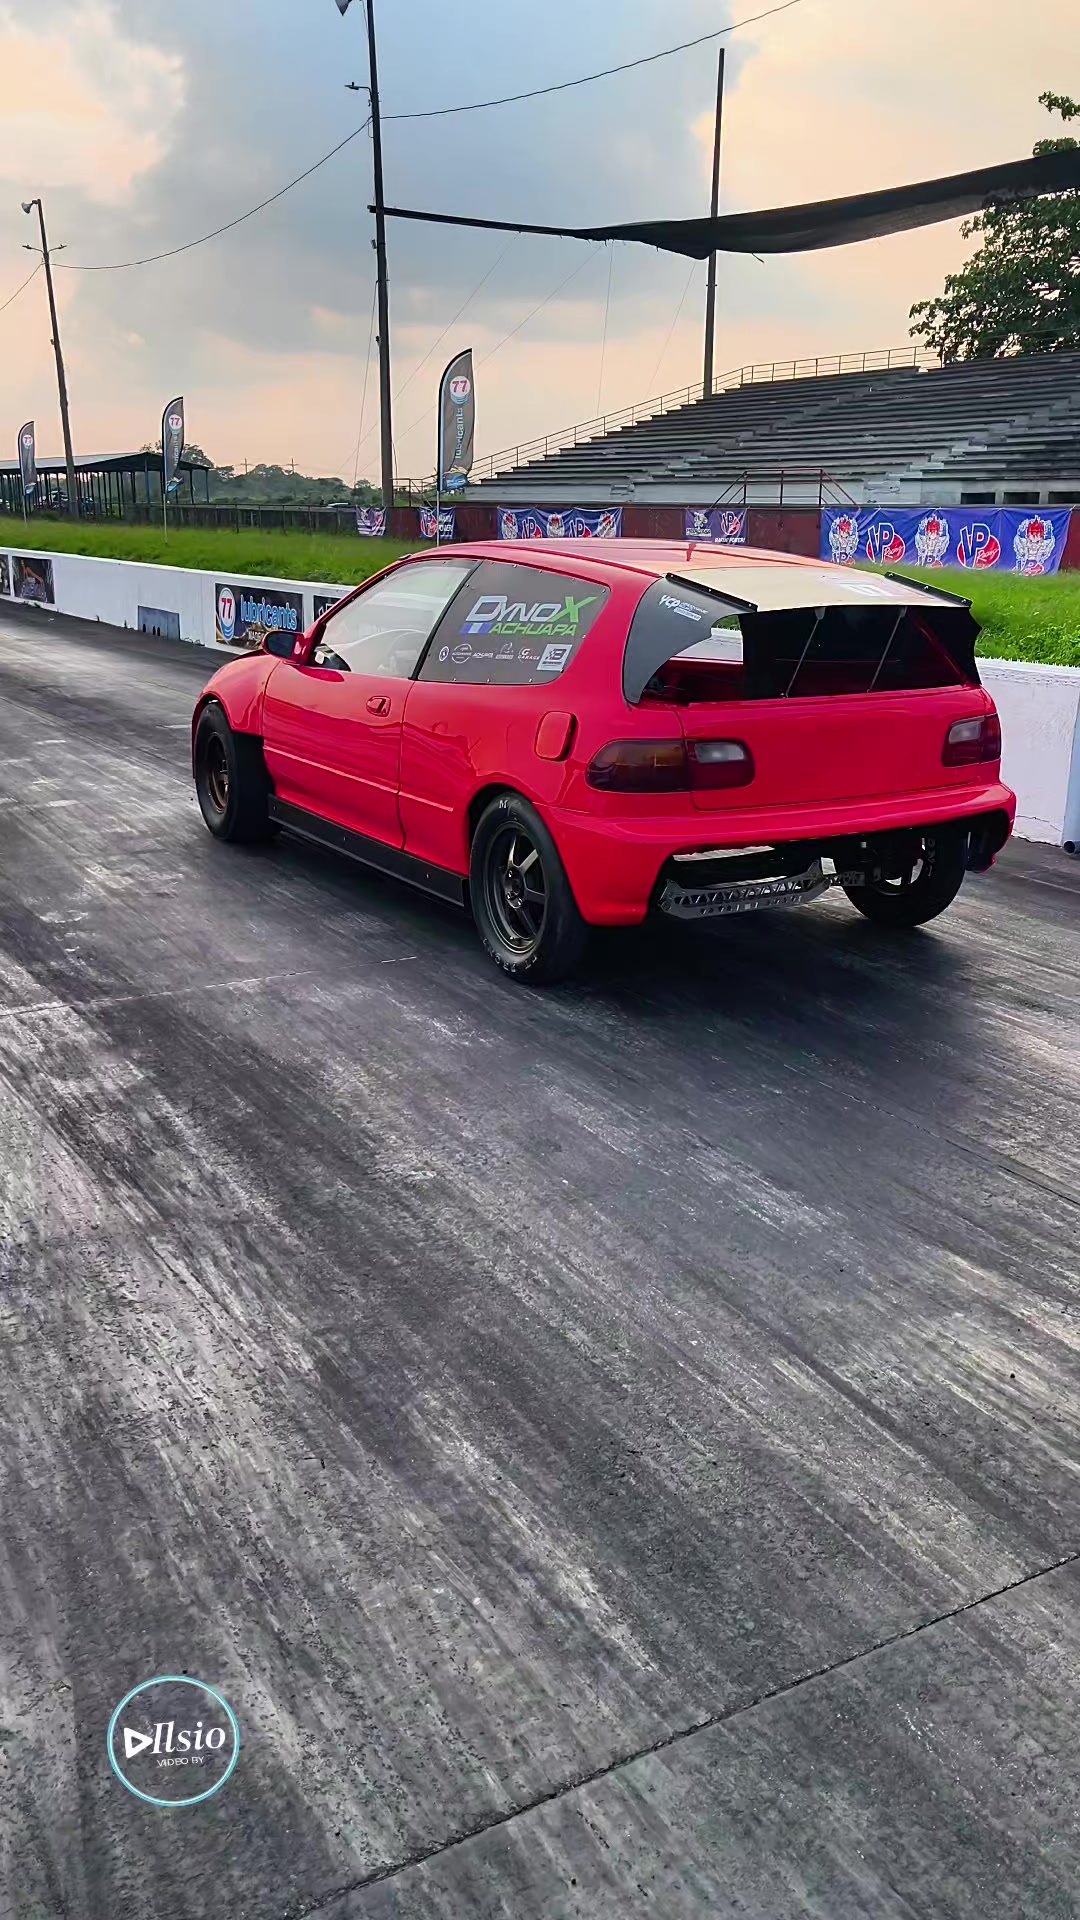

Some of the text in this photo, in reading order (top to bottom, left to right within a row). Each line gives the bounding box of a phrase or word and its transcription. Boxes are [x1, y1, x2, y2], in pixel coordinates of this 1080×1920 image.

[452, 380, 468, 393] 77
[169, 417, 181, 426] 77
[867, 522, 895, 563] VP
[959, 523, 991, 568] VP
[976, 547, 999, 562] Racing
[221, 597, 233, 619] 77
[241, 595, 297, 630] lubricants
[489, 623, 577, 636] ACHUAPA
